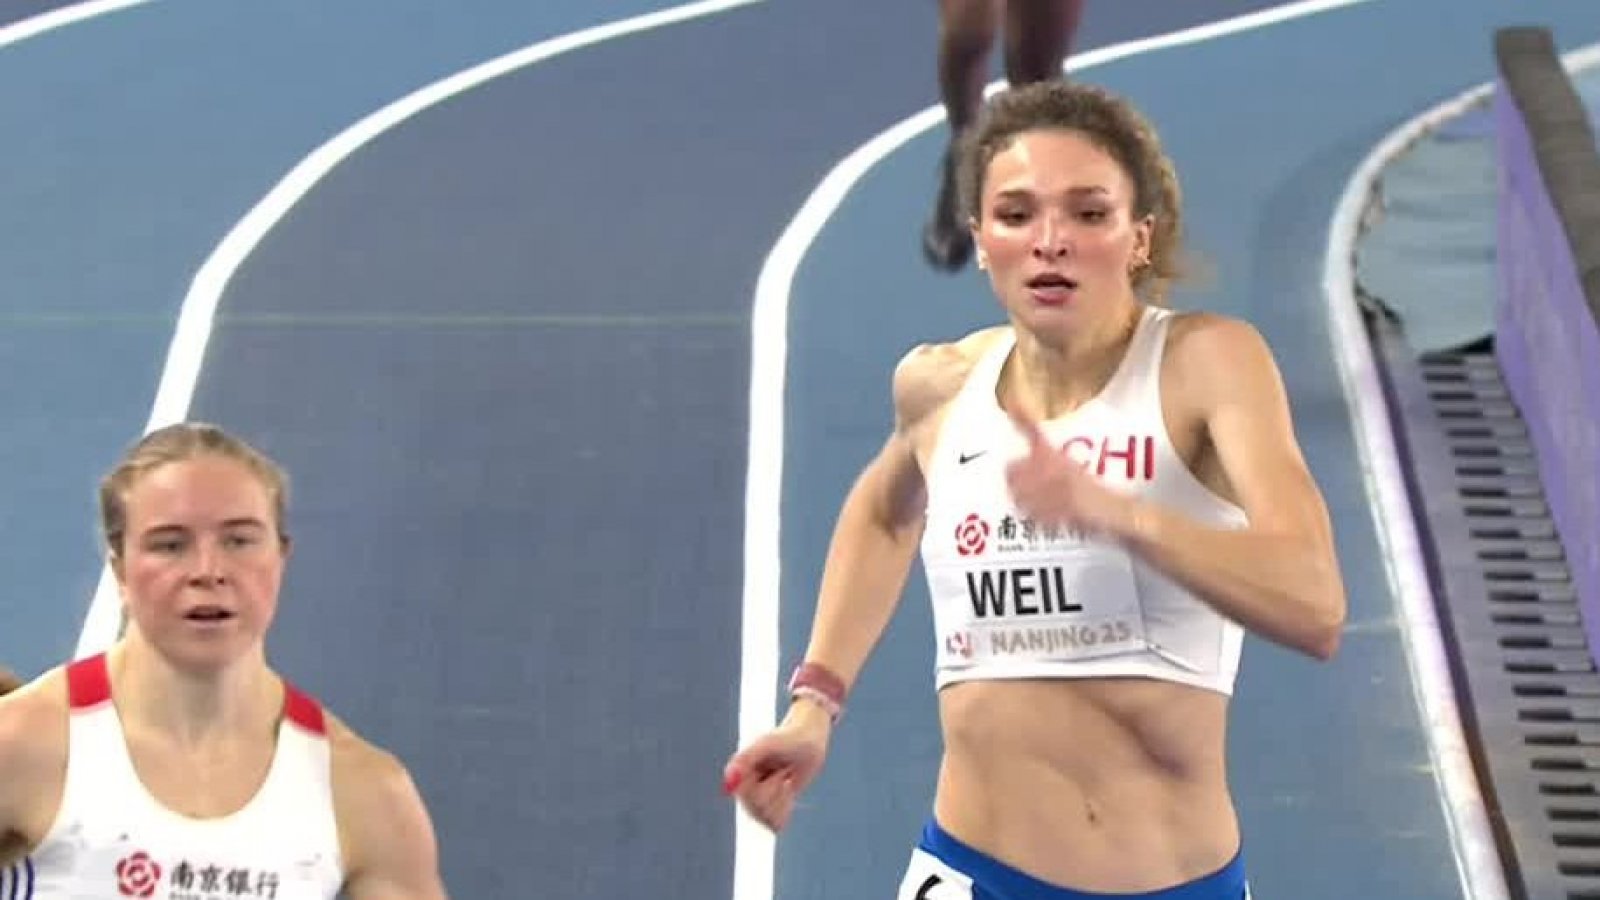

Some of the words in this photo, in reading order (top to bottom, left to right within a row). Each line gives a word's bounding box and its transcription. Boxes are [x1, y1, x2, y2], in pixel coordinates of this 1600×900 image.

[966, 567, 1083, 617] WEIL
[170, 859, 279, 899] 南京银行
